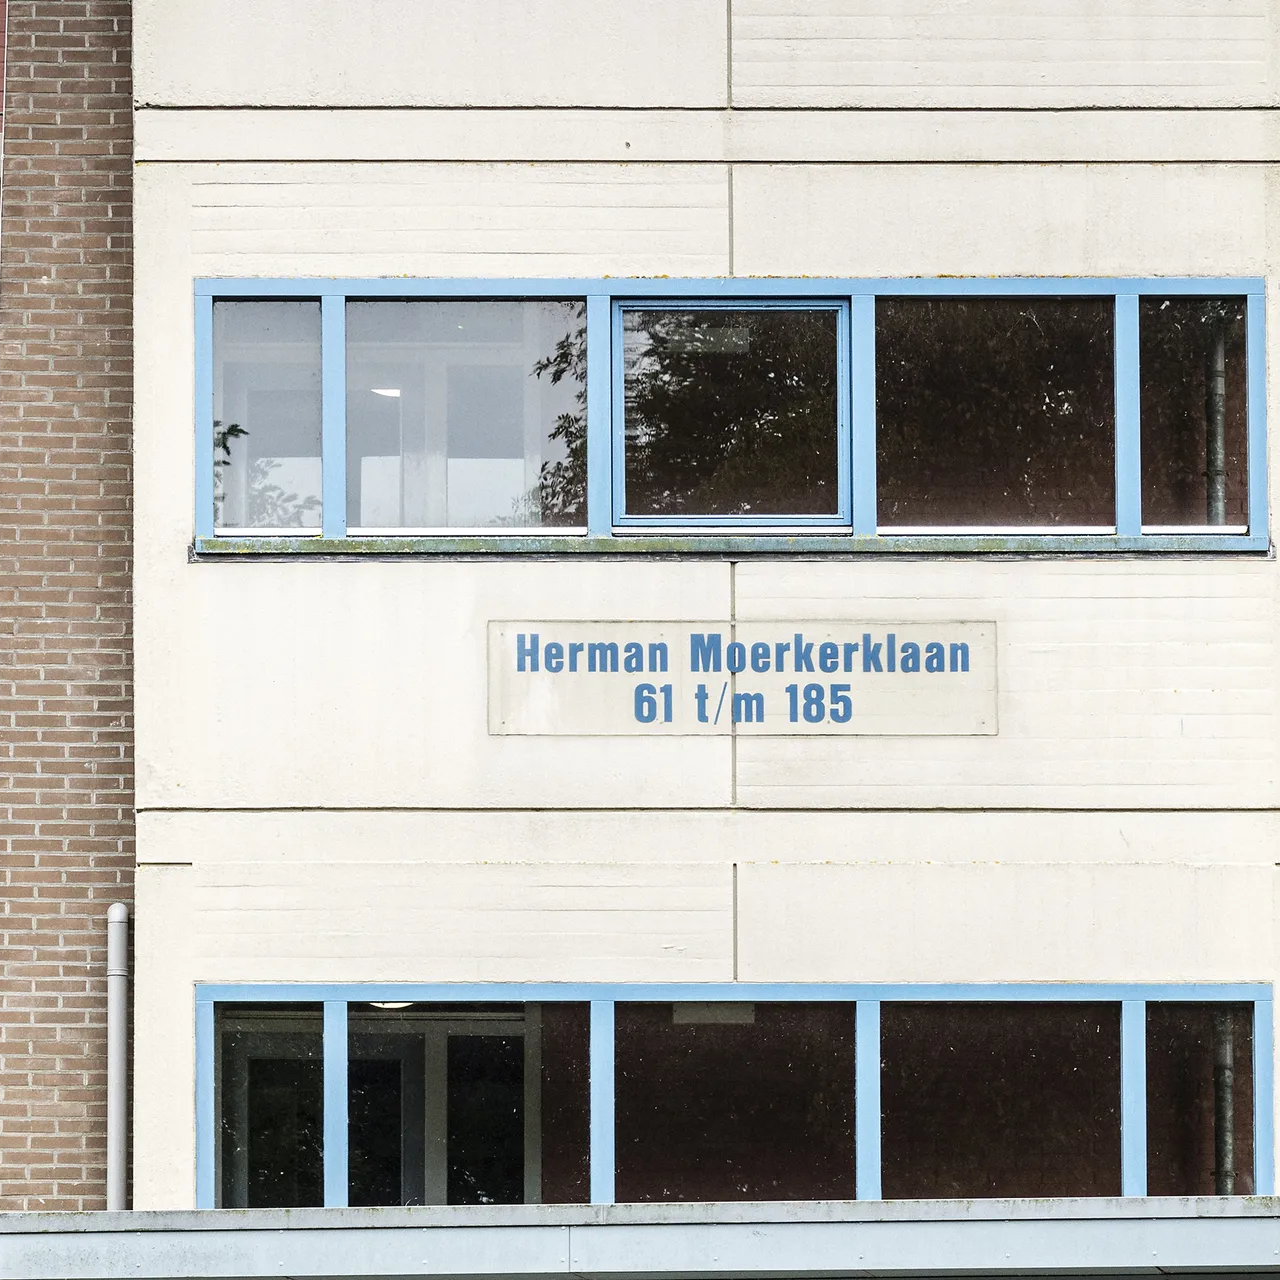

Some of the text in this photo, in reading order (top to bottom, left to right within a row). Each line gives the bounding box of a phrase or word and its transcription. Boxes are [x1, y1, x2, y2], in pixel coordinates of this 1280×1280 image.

[517, 634, 970, 672] Herman Moerkerklaan
[634, 682, 853, 725] 61 t/m 185
